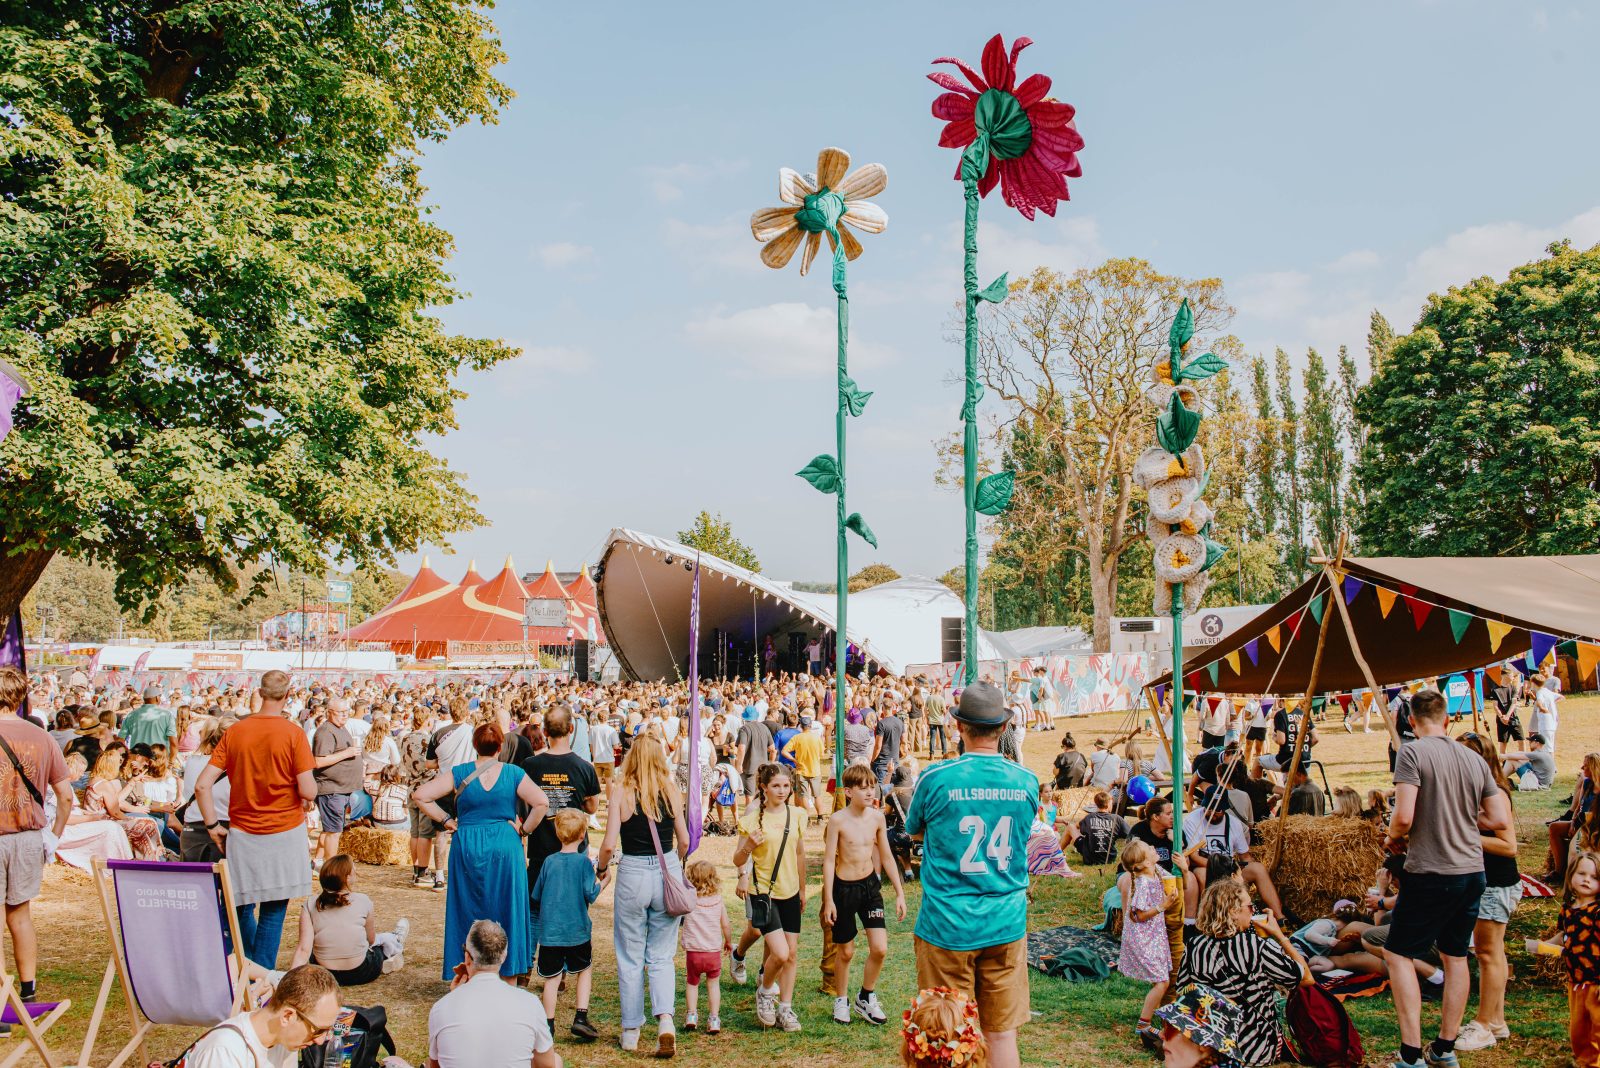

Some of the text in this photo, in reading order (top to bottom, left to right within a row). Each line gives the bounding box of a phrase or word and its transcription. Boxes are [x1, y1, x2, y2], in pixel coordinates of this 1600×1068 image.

[452, 642, 481, 653] HATS
[485, 643, 493, 652] &
[1288, 743, 1310, 752] TO
[948, 788, 1027, 802] HILLSBOROUGH
[958, 815, 1014, 876] 24
